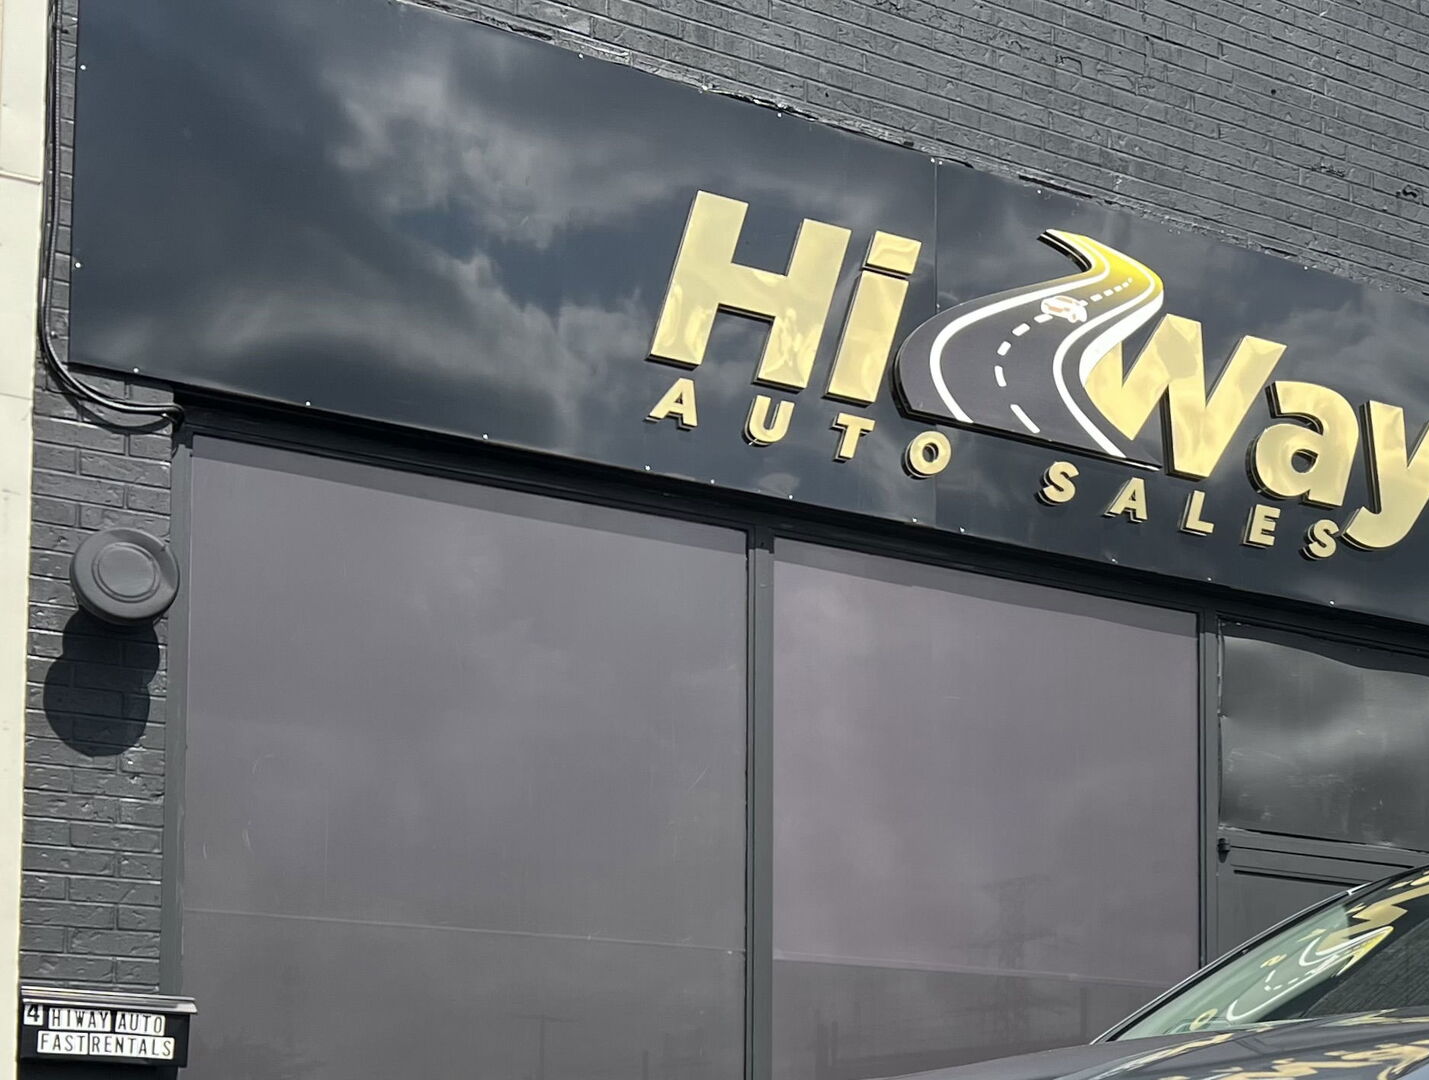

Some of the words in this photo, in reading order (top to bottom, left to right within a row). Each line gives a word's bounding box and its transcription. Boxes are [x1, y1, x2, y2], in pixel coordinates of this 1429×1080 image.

[645, 377, 952, 479] AUTO
[1037, 461, 1345, 560] SALES
[51, 1009, 109, 1029] HIWAY
[117, 1013, 163, 1034] AUTO
